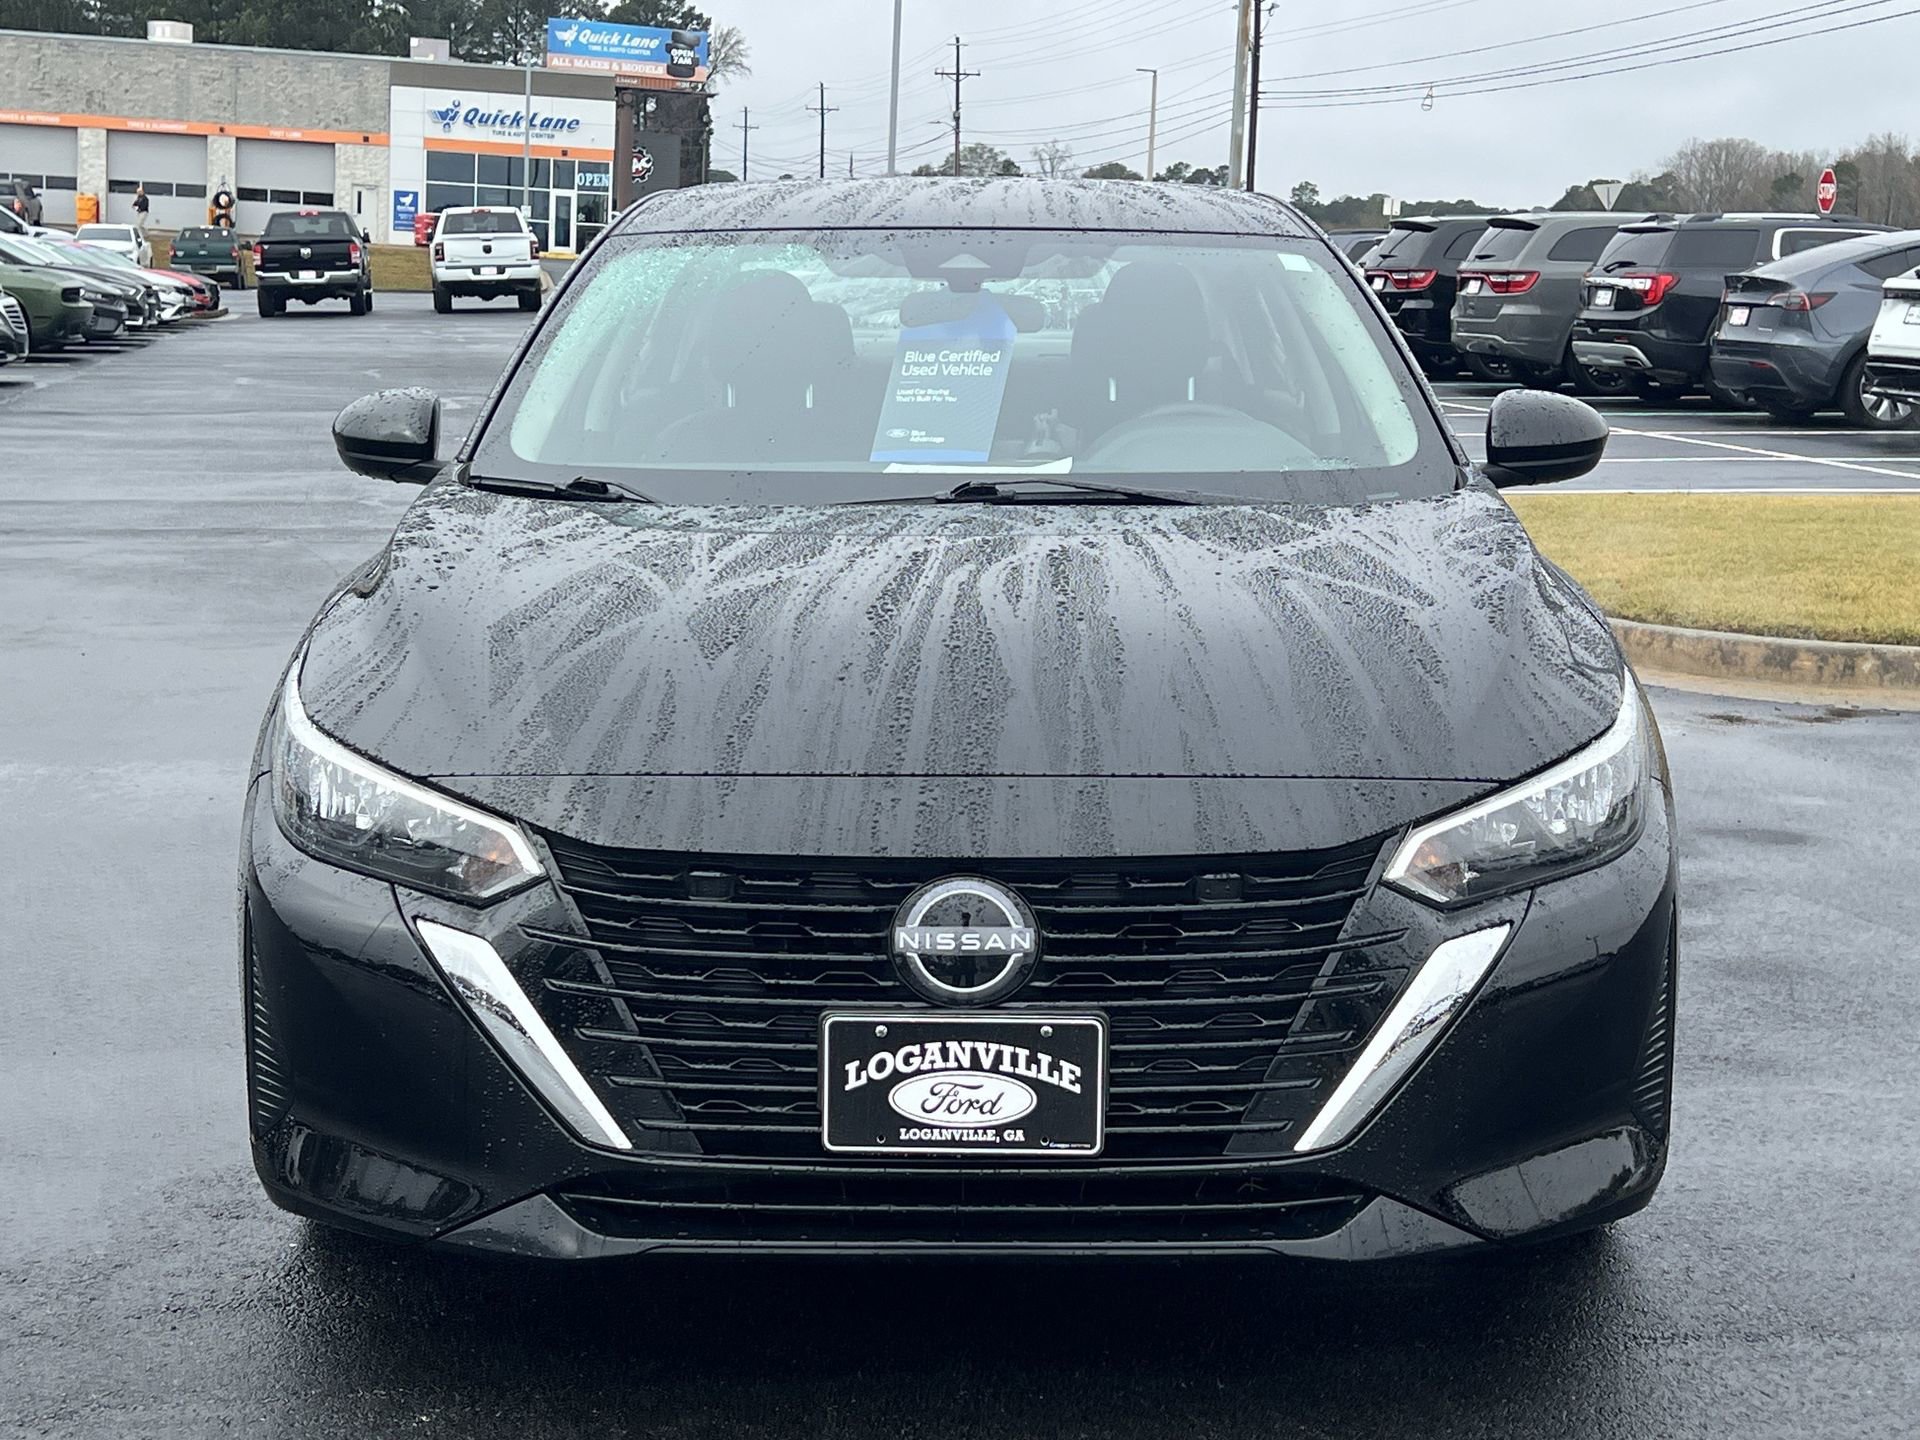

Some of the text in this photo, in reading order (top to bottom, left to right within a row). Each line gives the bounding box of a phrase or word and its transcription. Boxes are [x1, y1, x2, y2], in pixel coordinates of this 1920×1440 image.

[578, 29, 660, 49] Quick Lane
[627, 48, 651, 56] CENTER
[670, 48, 694, 57] OPEN
[551, 57, 664, 75] ALL MAKES & MODELS
[672, 56, 693, 65] 7AM
[463, 107, 581, 131] Quick Lane
[577, 172, 609, 186] OPEN
[1817, 183, 1836, 200] STOP
[904, 349, 1001, 363] Blue Certified
[901, 363, 993, 376] Used Vehicle
[899, 932, 1030, 950] NISSAN
[844, 1040, 1082, 1095] LOGANVILLE
[920, 1081, 1005, 1116] Ford
[899, 1128, 1025, 1143] LOGANVILLE, GA
